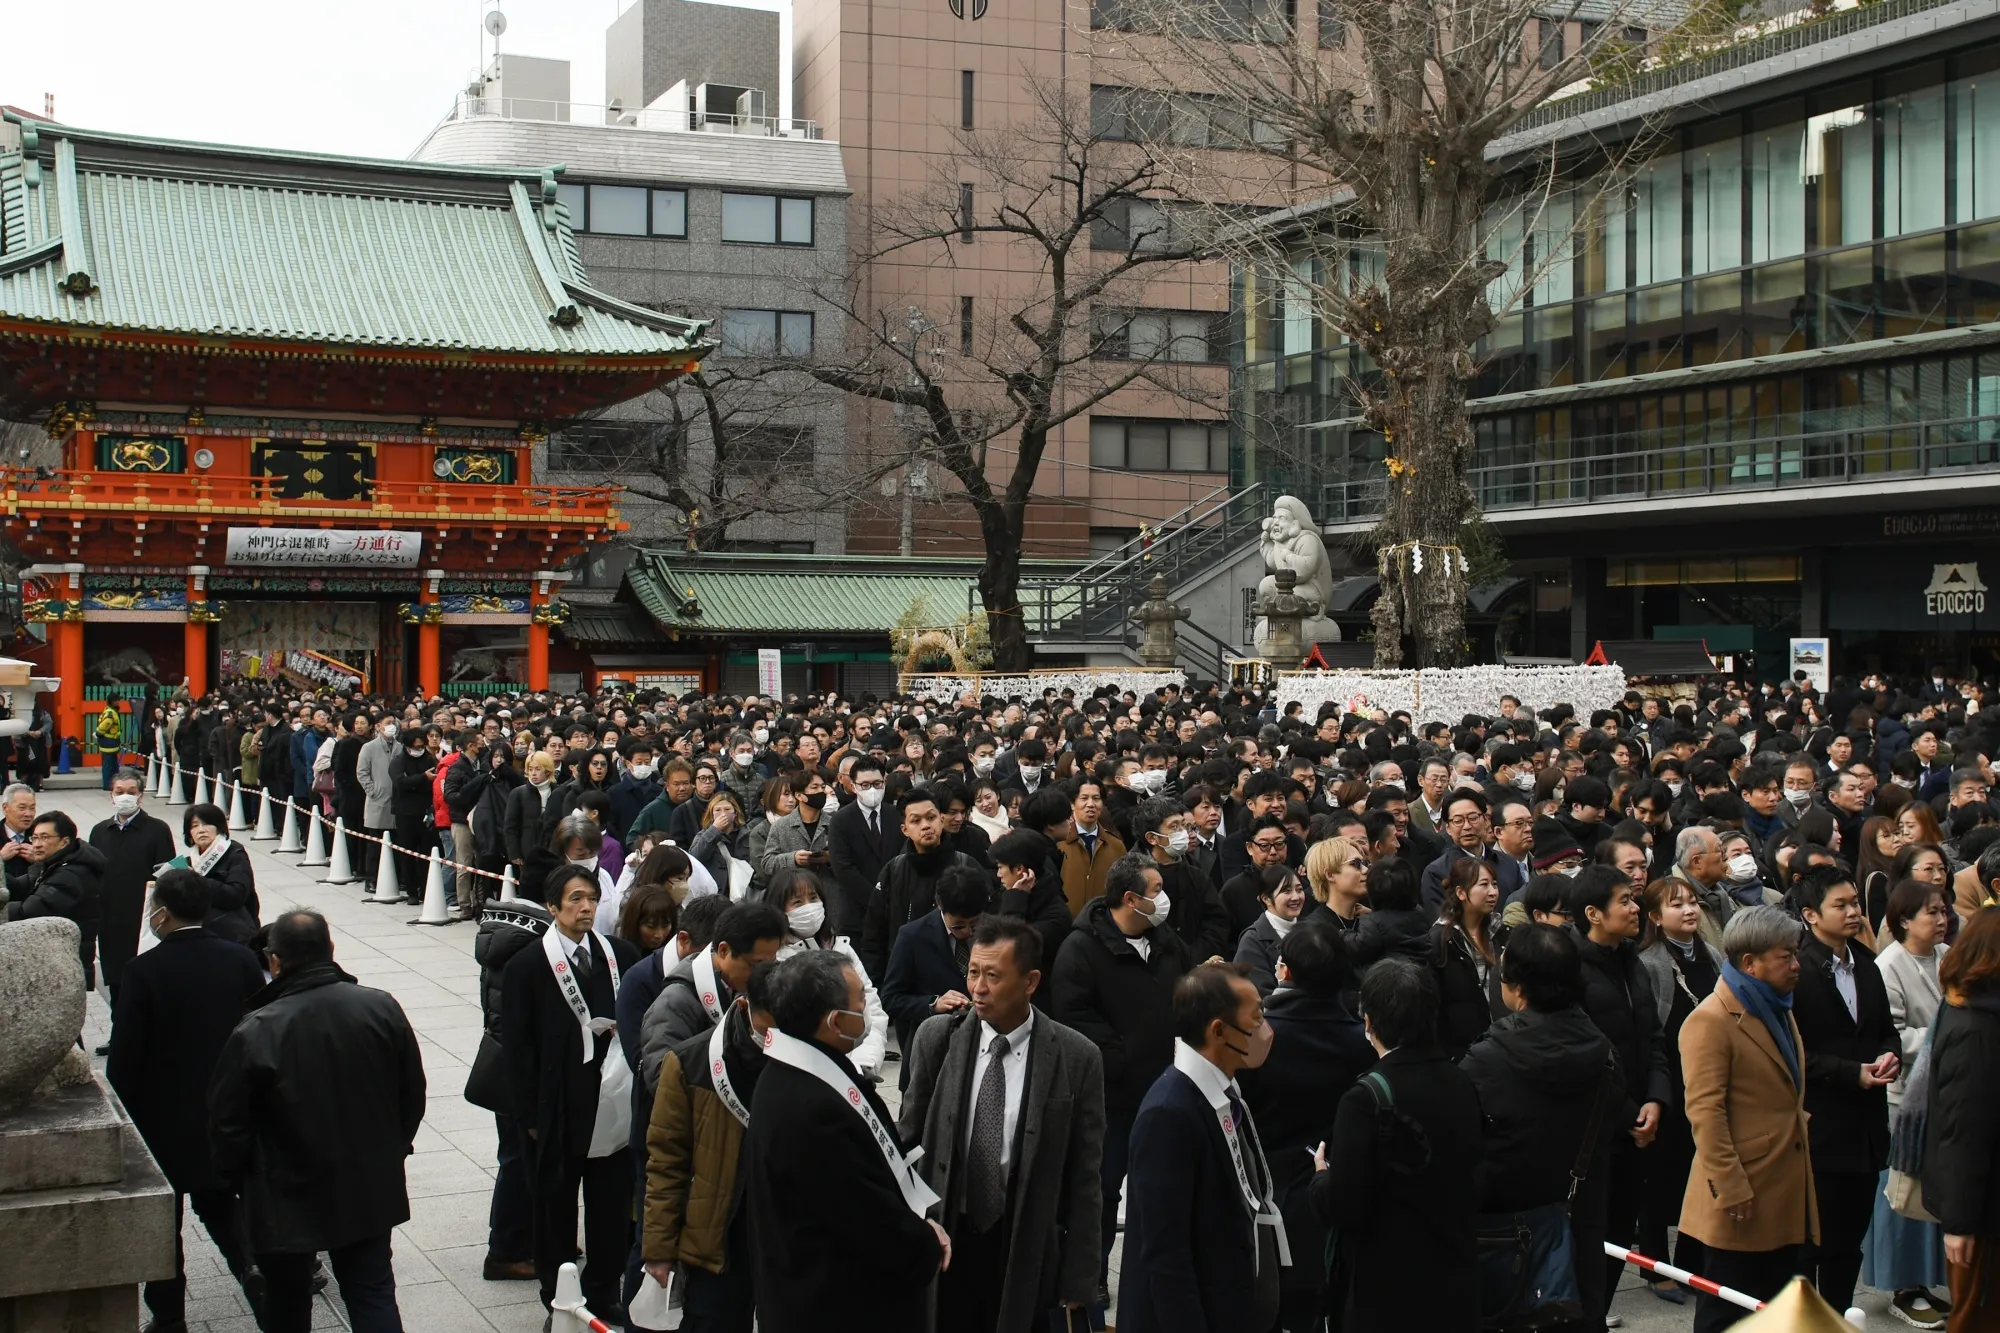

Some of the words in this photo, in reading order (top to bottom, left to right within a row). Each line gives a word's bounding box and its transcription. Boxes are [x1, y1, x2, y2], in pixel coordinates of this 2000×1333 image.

[247, 535, 331, 550] 神門は混雑時
[336, 536, 403, 551] 一方通行
[231, 551, 413, 565] お帰りは左右にお進みください
[1926, 591, 1986, 616] EDOCCO
[562, 974, 586, 1016] 神田明神
[861, 1103, 896, 1162] 神田明神
